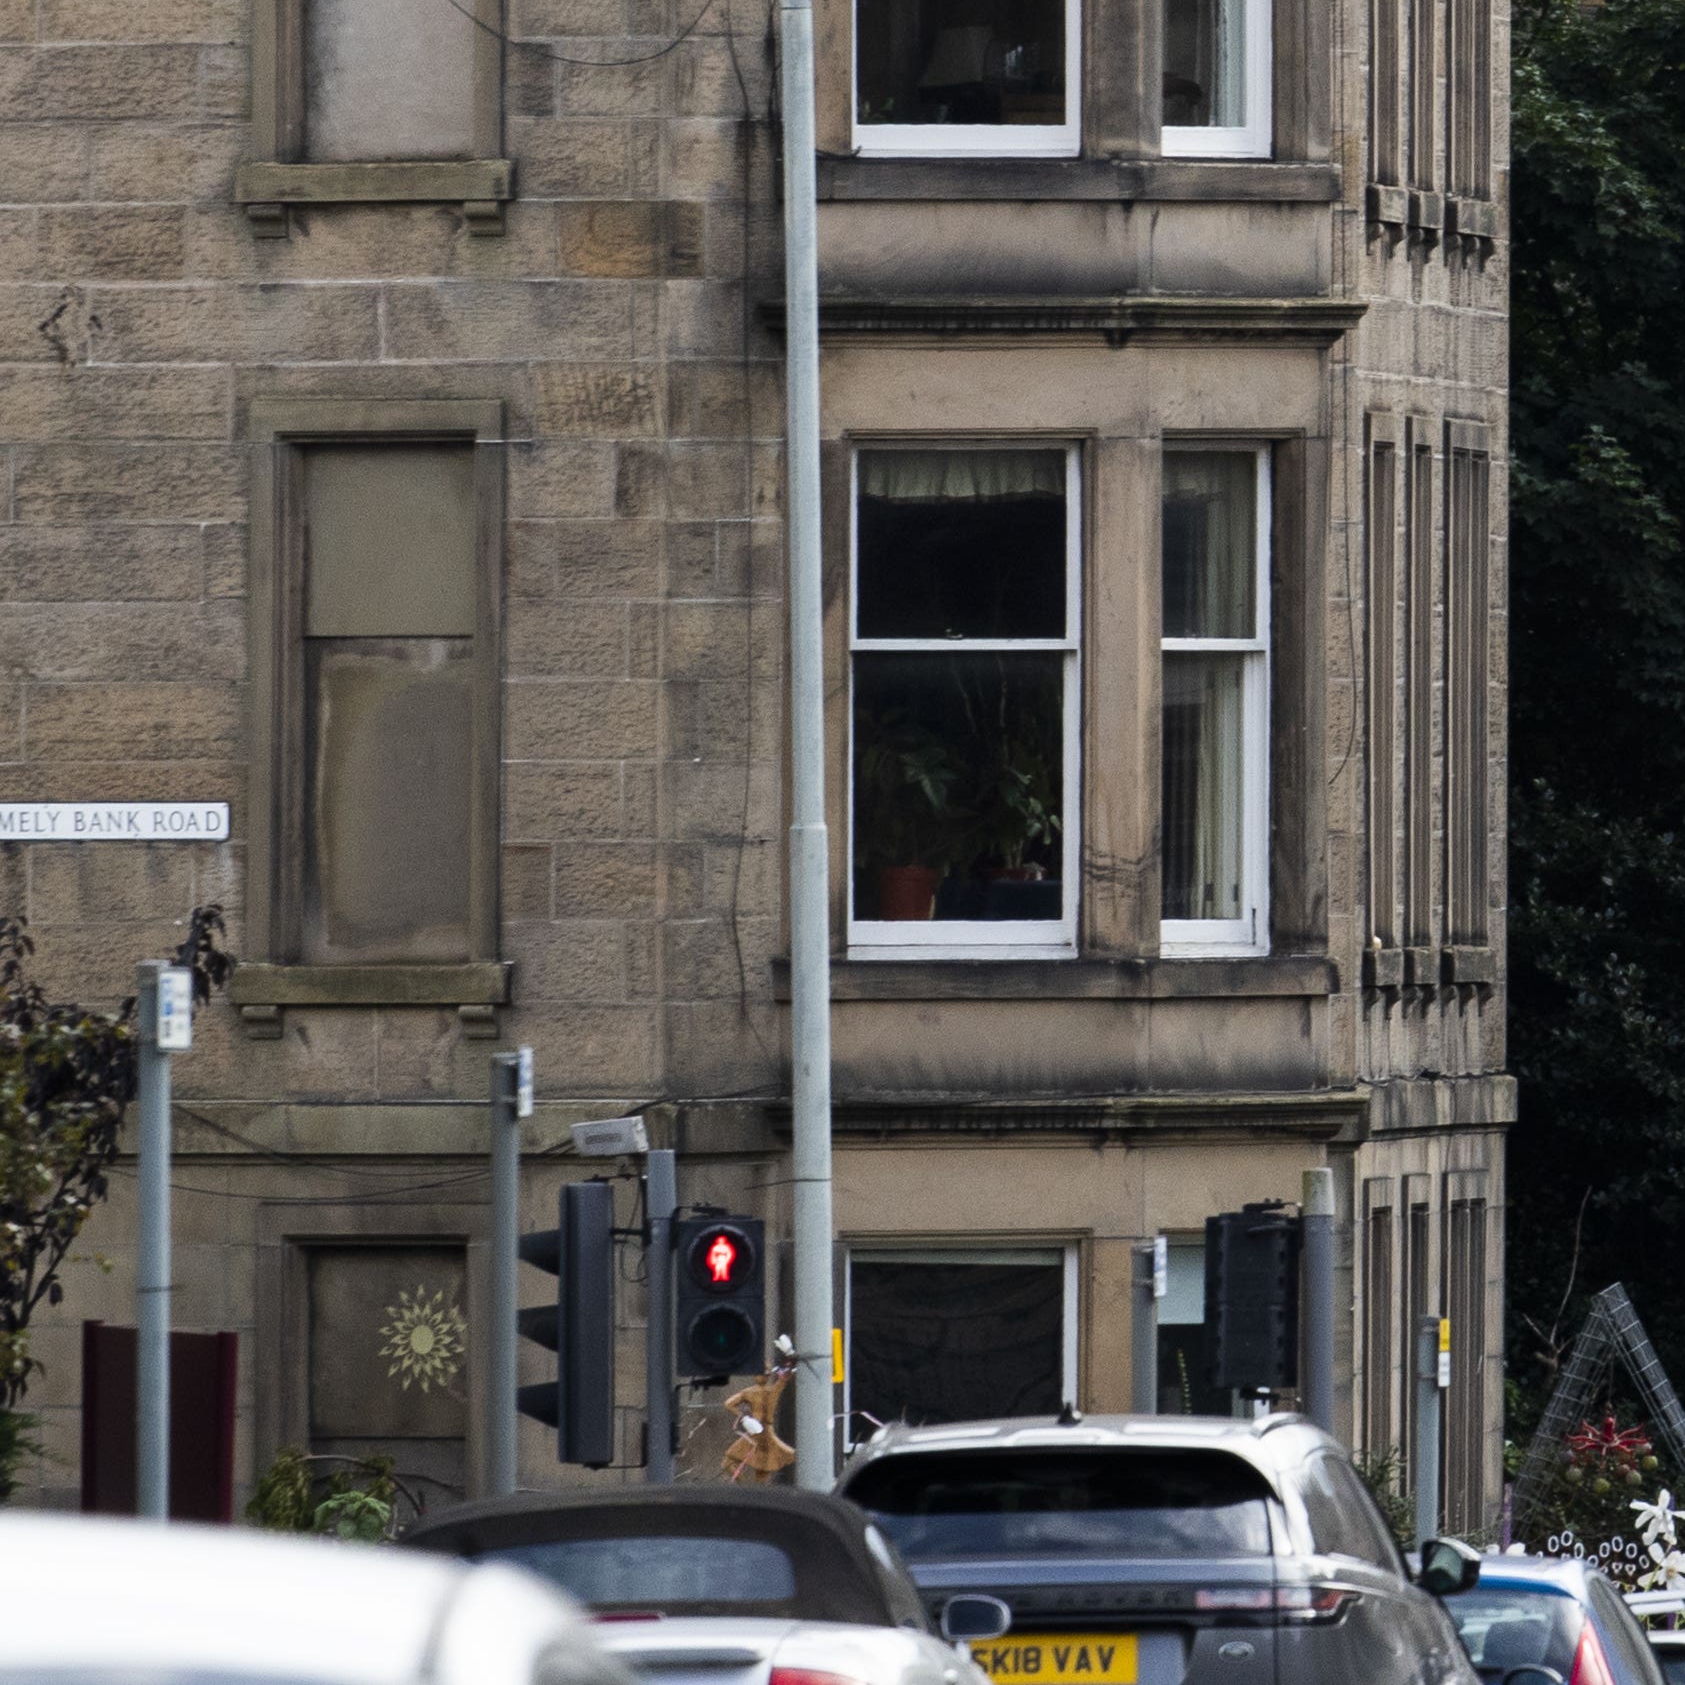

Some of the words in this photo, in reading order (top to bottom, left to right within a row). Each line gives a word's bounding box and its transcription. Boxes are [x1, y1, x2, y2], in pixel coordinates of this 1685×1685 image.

[73, 810, 141, 832] BANK
[152, 810, 222, 832] ROAD
[971, 1645, 1042, 1675] SK18
[1051, 1645, 1116, 1674] VAV
